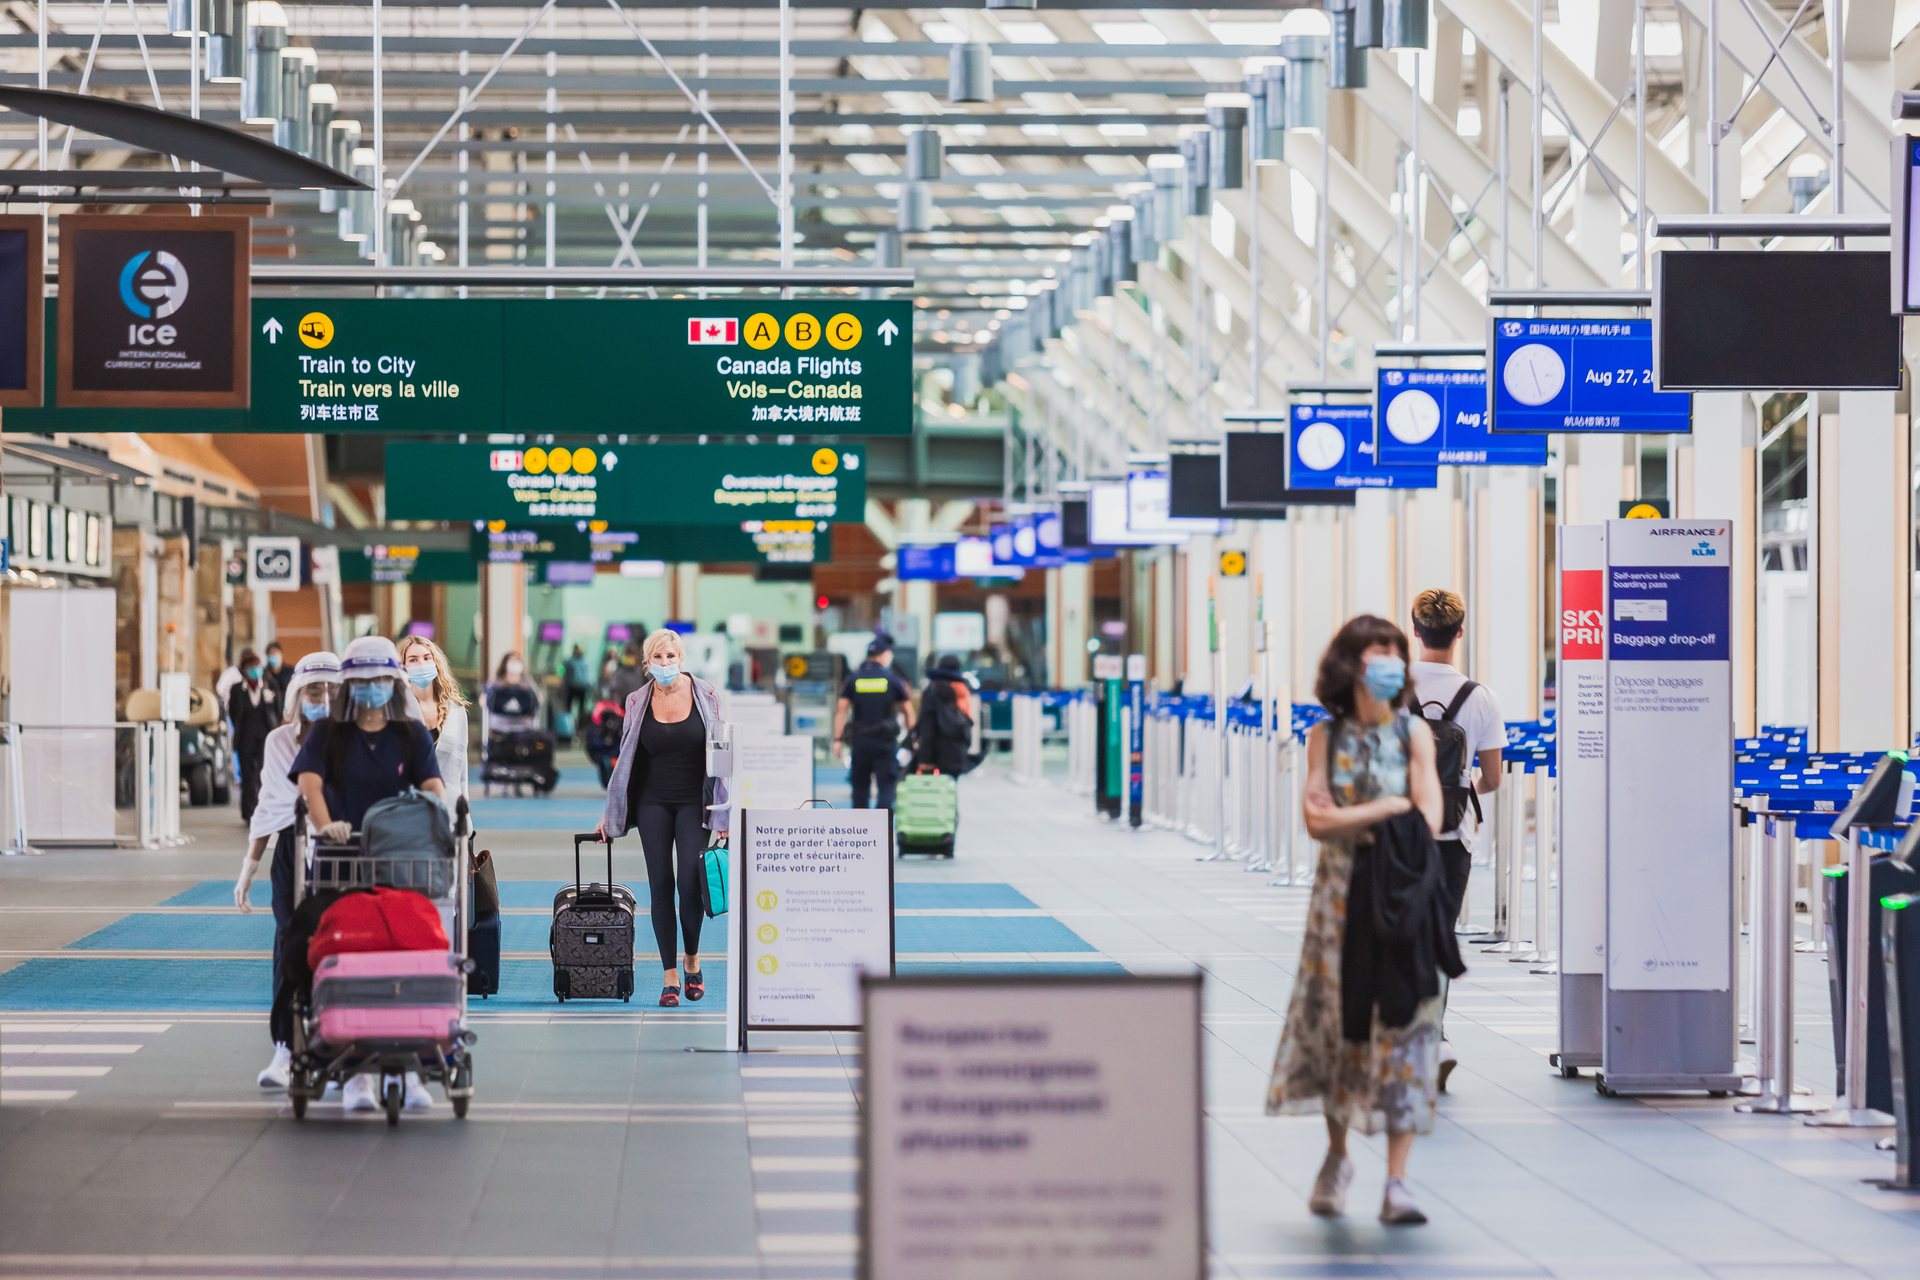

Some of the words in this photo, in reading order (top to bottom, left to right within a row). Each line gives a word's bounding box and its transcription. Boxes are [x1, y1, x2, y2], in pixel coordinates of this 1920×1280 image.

[753, 322, 770, 341] A
[796, 322, 812, 341] B
[836, 321, 854, 342] C
[299, 356, 345, 373] Train
[352, 357, 371, 373] to
[377, 356, 415, 376] City
[716, 356, 791, 374] Canada
[797, 357, 862, 378] Flights
[1585, 369, 1612, 386] Aug
[1616, 370, 1637, 386] 27,
[299, 380, 345, 397] Train
[352, 385, 392, 398] vers
[399, 380, 414, 398] la
[421, 380, 459, 398] ville
[300, 405, 379, 421] 列车往市区
[752, 405, 861, 422] 加拿大境内航班
[1456, 411, 1480, 427] Aug
[1650, 528, 1716, 536] AIRFRANCE
[1613, 572, 1658, 580] Self-service
[1660, 572, 1680, 580] kiosk
[1613, 580, 1647, 590] boarding
[1648, 582, 1668, 590] pass
[1563, 628, 1603, 644] PRI
[1614, 634, 1666, 647] Baggage
[1669, 633, 1716, 646] drop-off
[1614, 676, 1655, 687] Dépose
[1658, 676, 1703, 688] bagages
[756, 826, 784, 835] Notre
[787, 826, 825, 836] priorité
[829, 826, 868, 835] absolue
[775, 839, 786, 847] de
[790, 839, 824, 849] garder
[827, 839, 877, 849] l'aéroport
[756, 852, 790, 862] propre
[793, 852, 803, 860] et
[806, 851, 864, 860] sécuritaire.
[756, 864, 787, 872] Faites
[819, 866, 841, 874] part
[785, 889, 817, 897] Respectez
[785, 897, 831, 905] d'éloignement
[847, 906, 873, 914] possible
